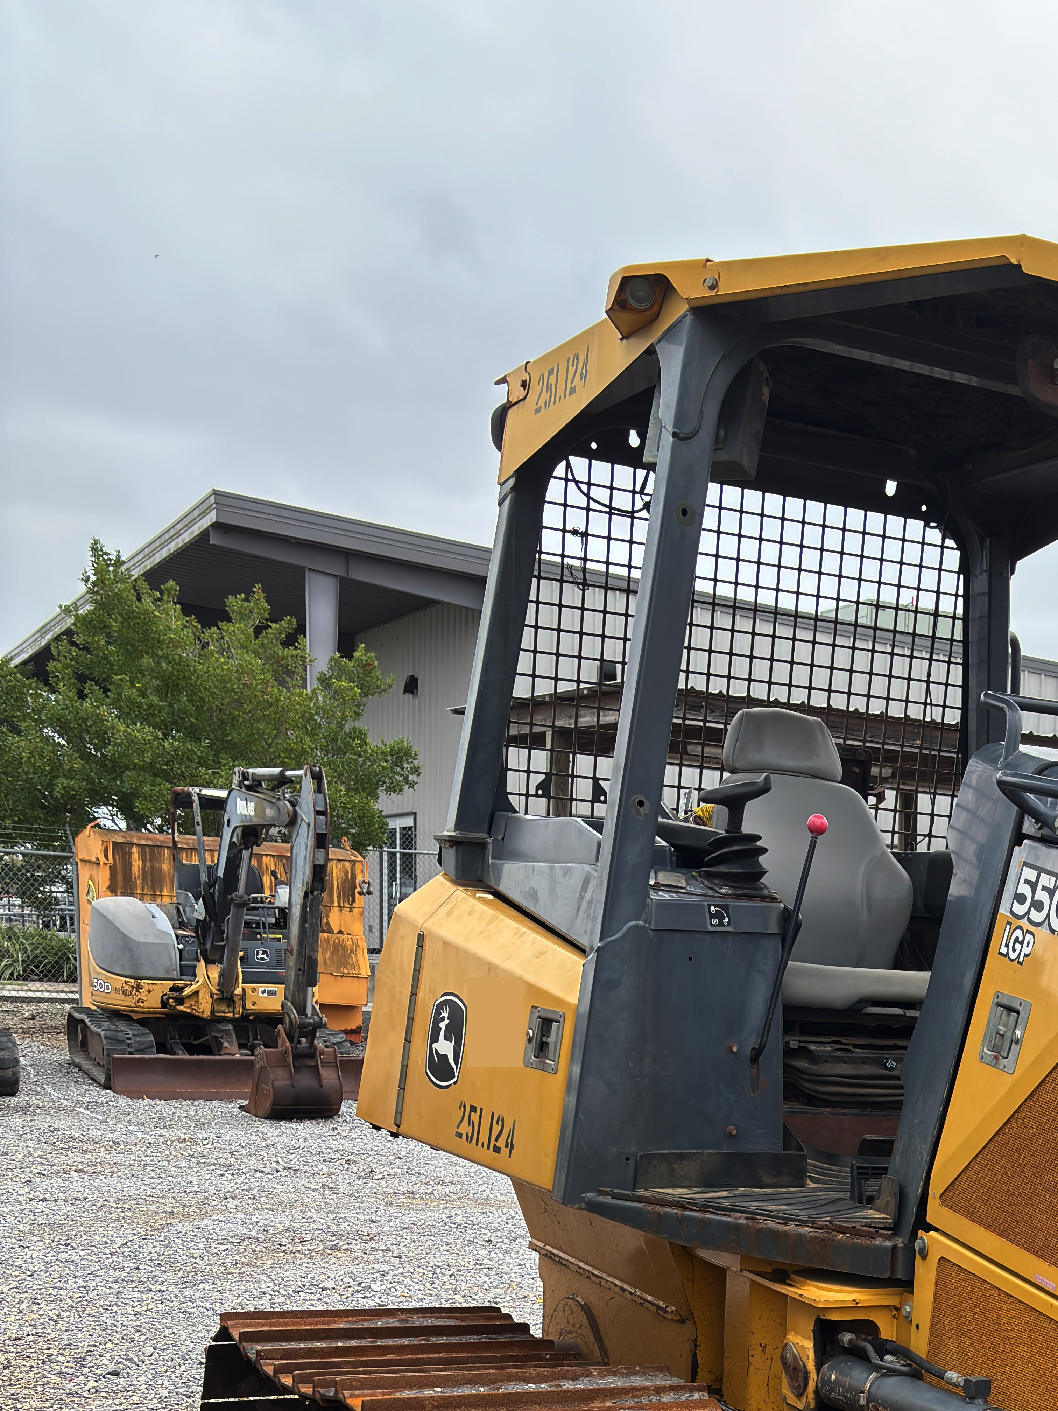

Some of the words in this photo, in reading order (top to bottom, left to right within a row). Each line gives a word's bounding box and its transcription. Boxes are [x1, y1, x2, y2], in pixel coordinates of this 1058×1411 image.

[533, 344, 590, 416] 251.124
[997, 919, 1036, 967] LGP
[454, 1099, 517, 1159] 251.124
